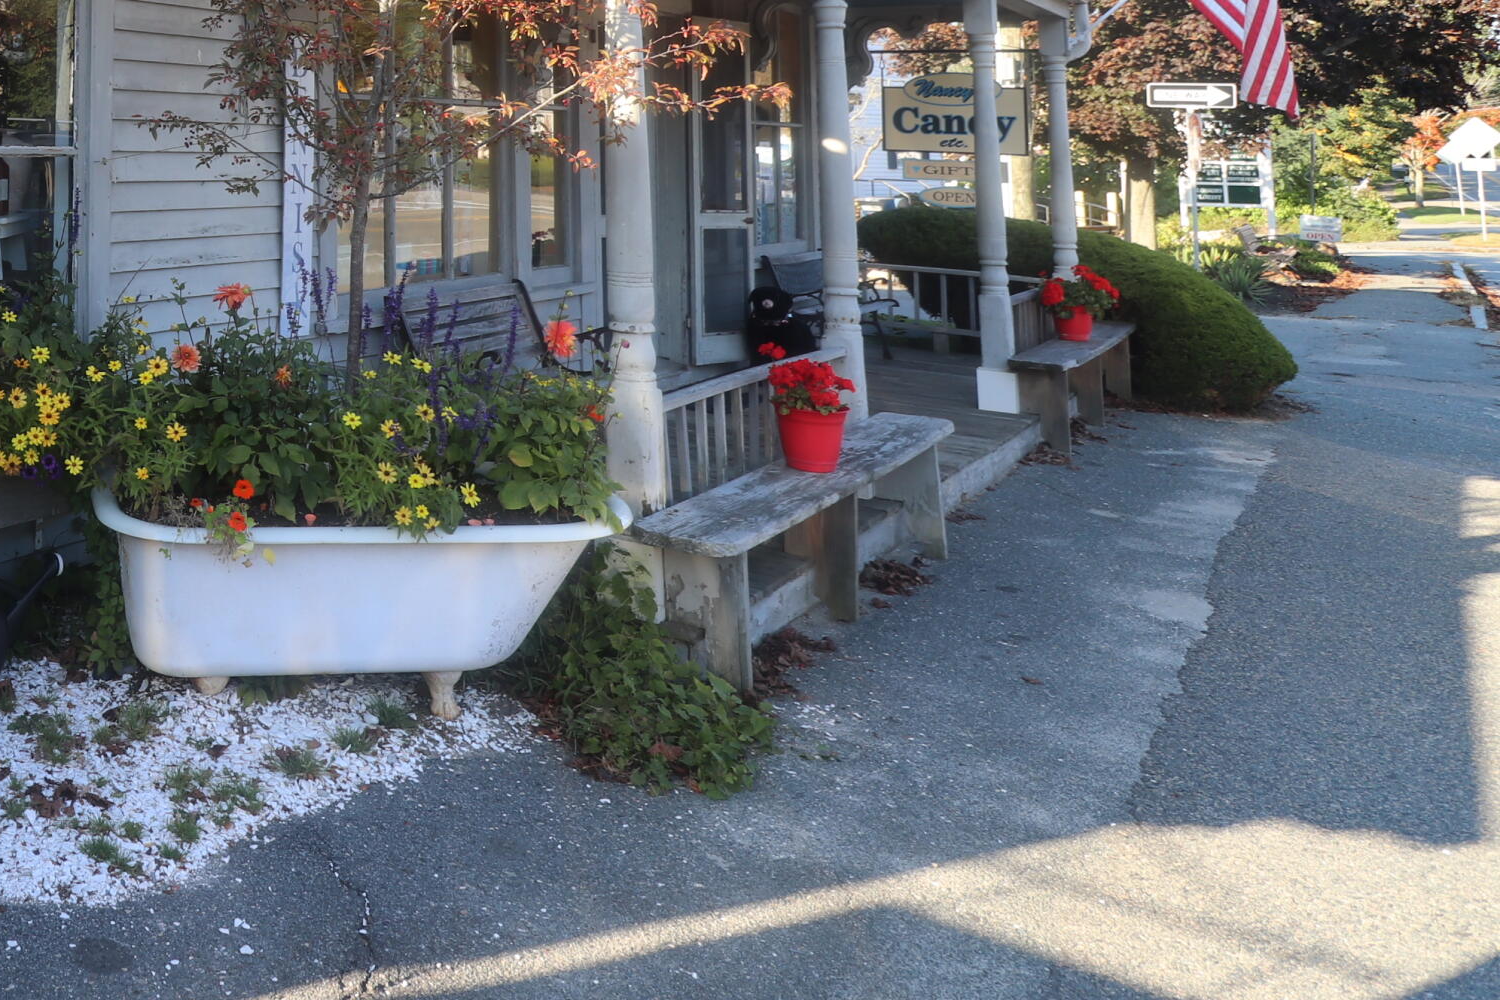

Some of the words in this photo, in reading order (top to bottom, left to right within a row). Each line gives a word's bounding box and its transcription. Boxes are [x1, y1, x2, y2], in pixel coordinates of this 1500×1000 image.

[892, 106, 1016, 142] Cany
[940, 137, 968, 148] etc.
[932, 191, 975, 203] OPEN
[1306, 232, 1335, 240] OPEN
